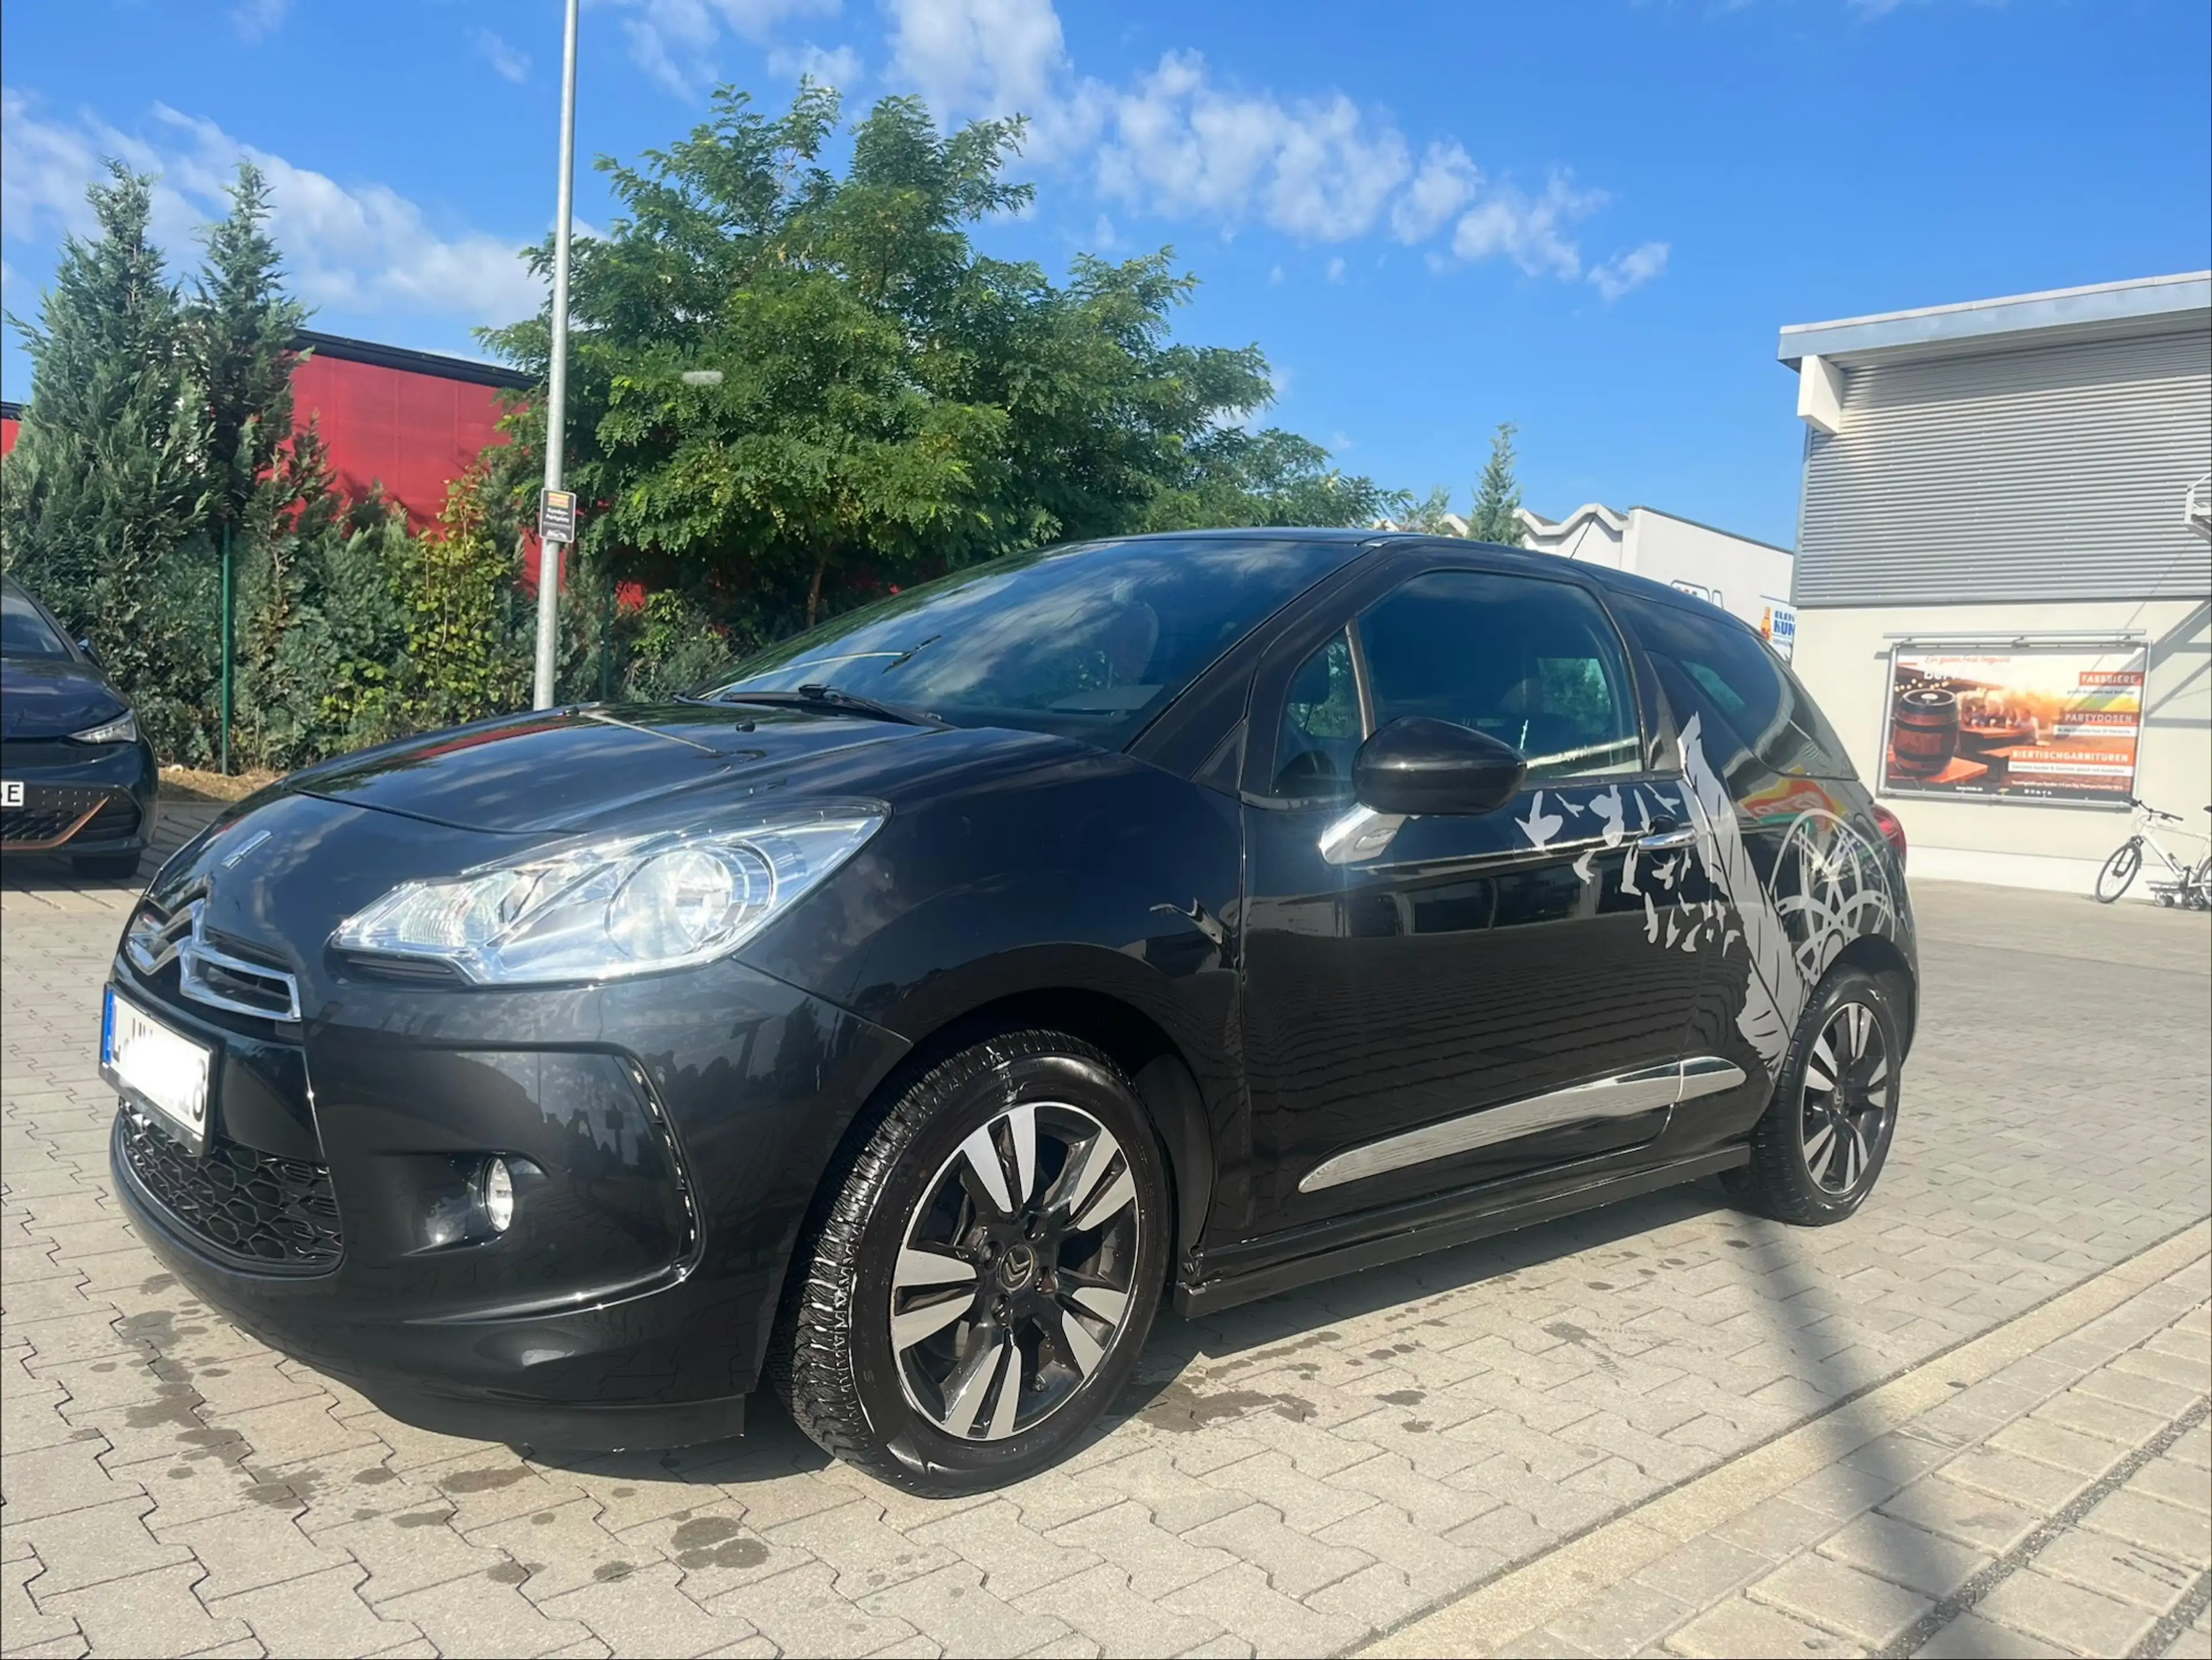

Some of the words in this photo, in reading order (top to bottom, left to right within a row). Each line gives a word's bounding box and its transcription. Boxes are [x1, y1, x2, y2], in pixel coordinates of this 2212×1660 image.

[2081, 674, 2137, 685] FASSBIERE
[2064, 712, 2132, 723] PARTYDOSEN
[2012, 750, 2128, 762] BIERTISCHGARNITUREN
